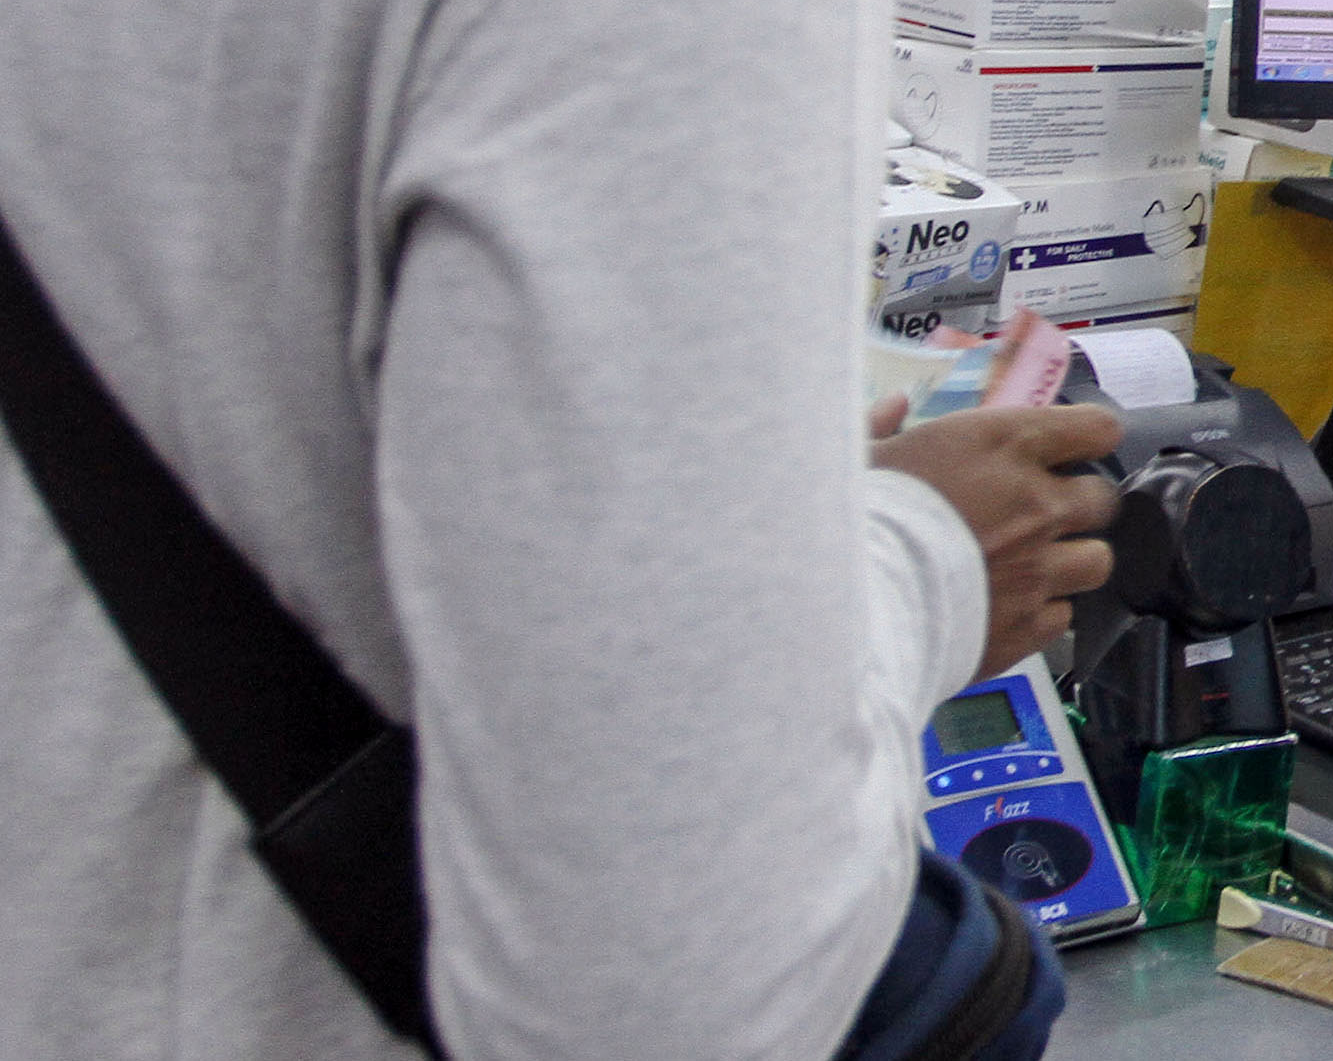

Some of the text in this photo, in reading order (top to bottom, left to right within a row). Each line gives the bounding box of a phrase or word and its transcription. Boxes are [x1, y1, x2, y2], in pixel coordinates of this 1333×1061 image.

[906, 220, 970, 254] Neo
[1046, 243, 1088, 256] FOR DAILY
[1067, 248, 1114, 262] PROTECTIVE
[883, 311, 941, 340] Neo
[983, 796, 1031, 822] Flazz
